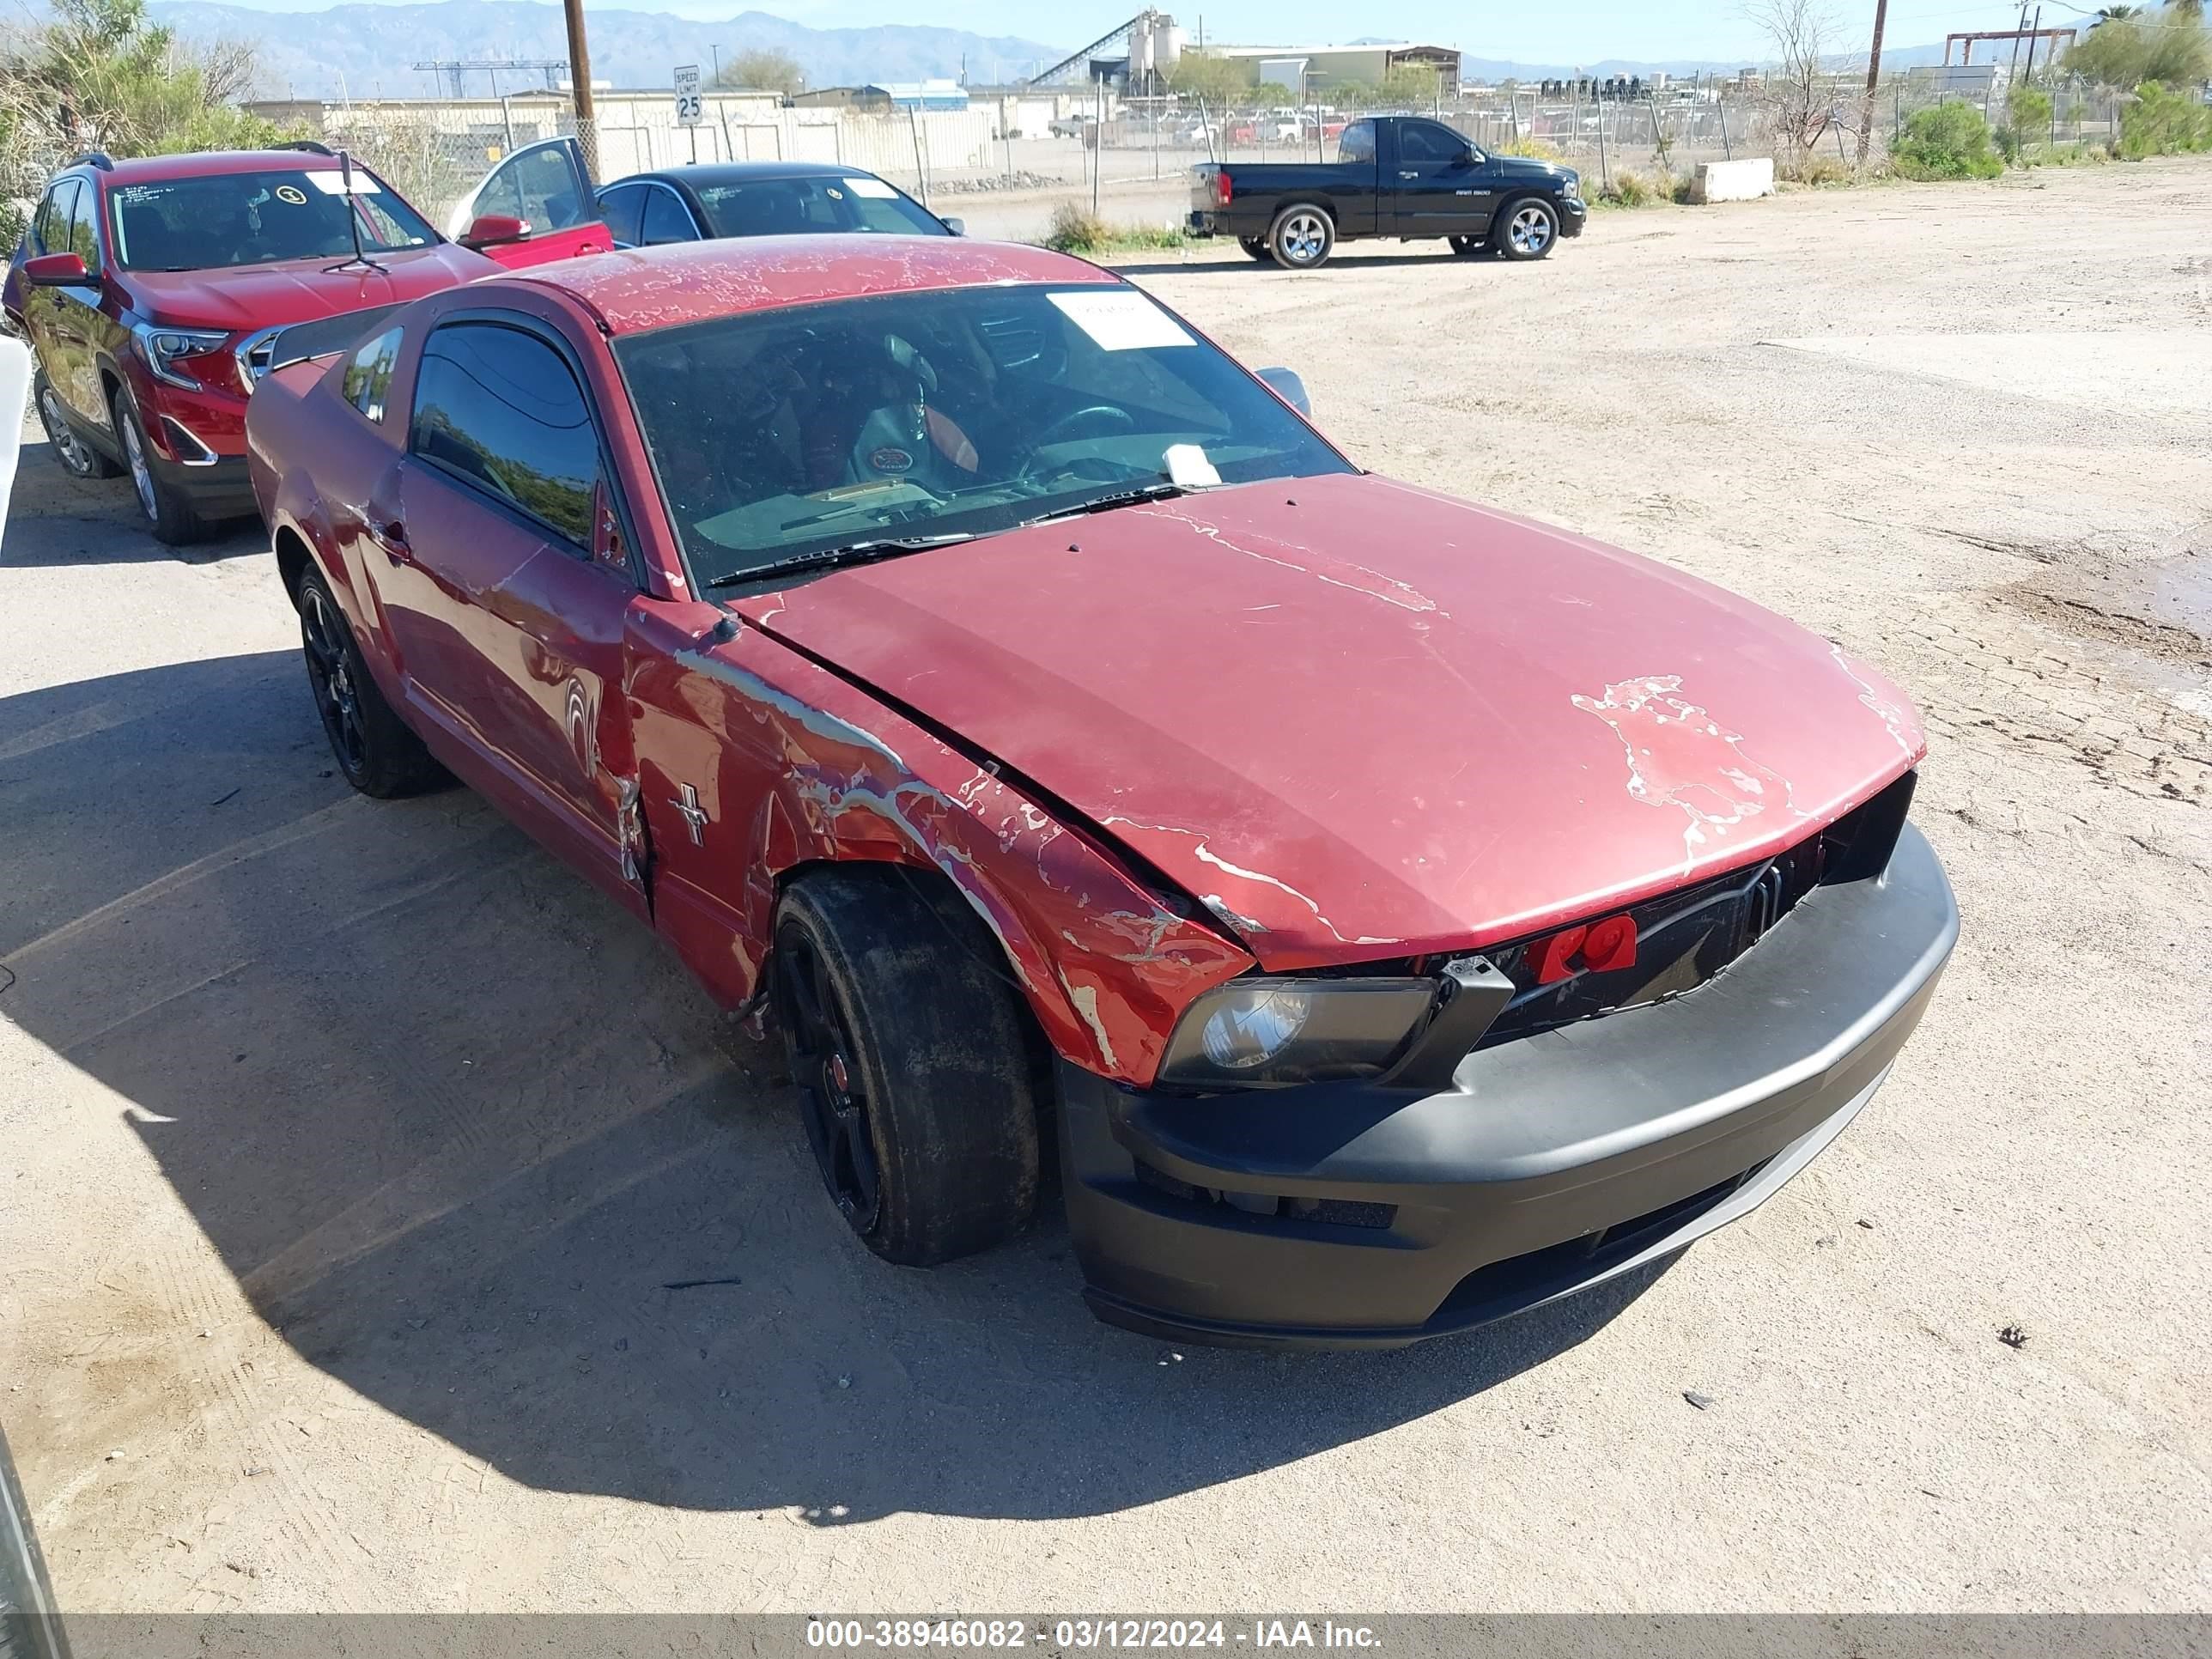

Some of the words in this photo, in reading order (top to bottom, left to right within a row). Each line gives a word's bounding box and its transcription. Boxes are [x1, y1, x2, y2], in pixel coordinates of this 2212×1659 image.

[677, 72, 698, 83] SPEED
[679, 84, 697, 94] LIMIT
[679, 96, 700, 118] 25
